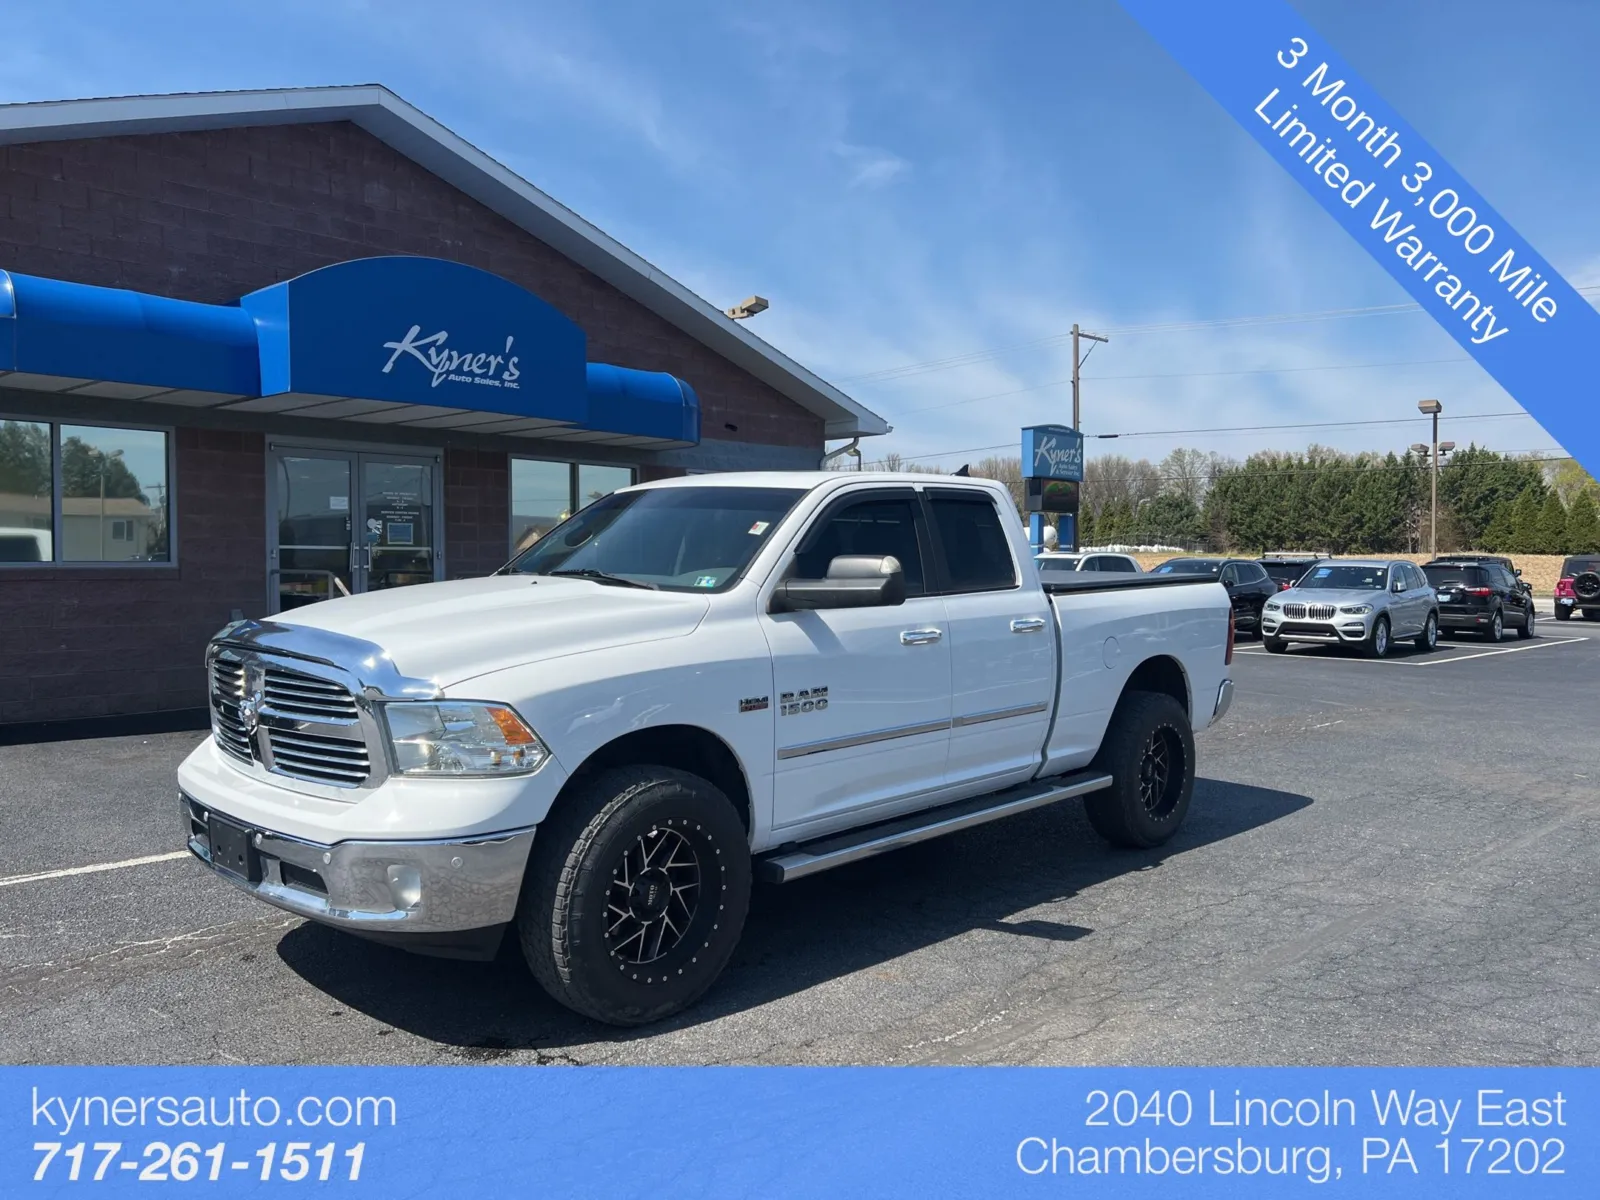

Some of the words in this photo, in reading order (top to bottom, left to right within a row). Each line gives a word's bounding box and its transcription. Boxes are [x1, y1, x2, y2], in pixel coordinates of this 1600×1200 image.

[382, 325, 520, 387] Kyner's
[448, 373, 472, 383] Auto
[474, 377, 501, 387] Sales,
[1034, 435, 1082, 476] Kyner's
[780, 686, 828, 704] RAM
[780, 698, 828, 717] 1500
